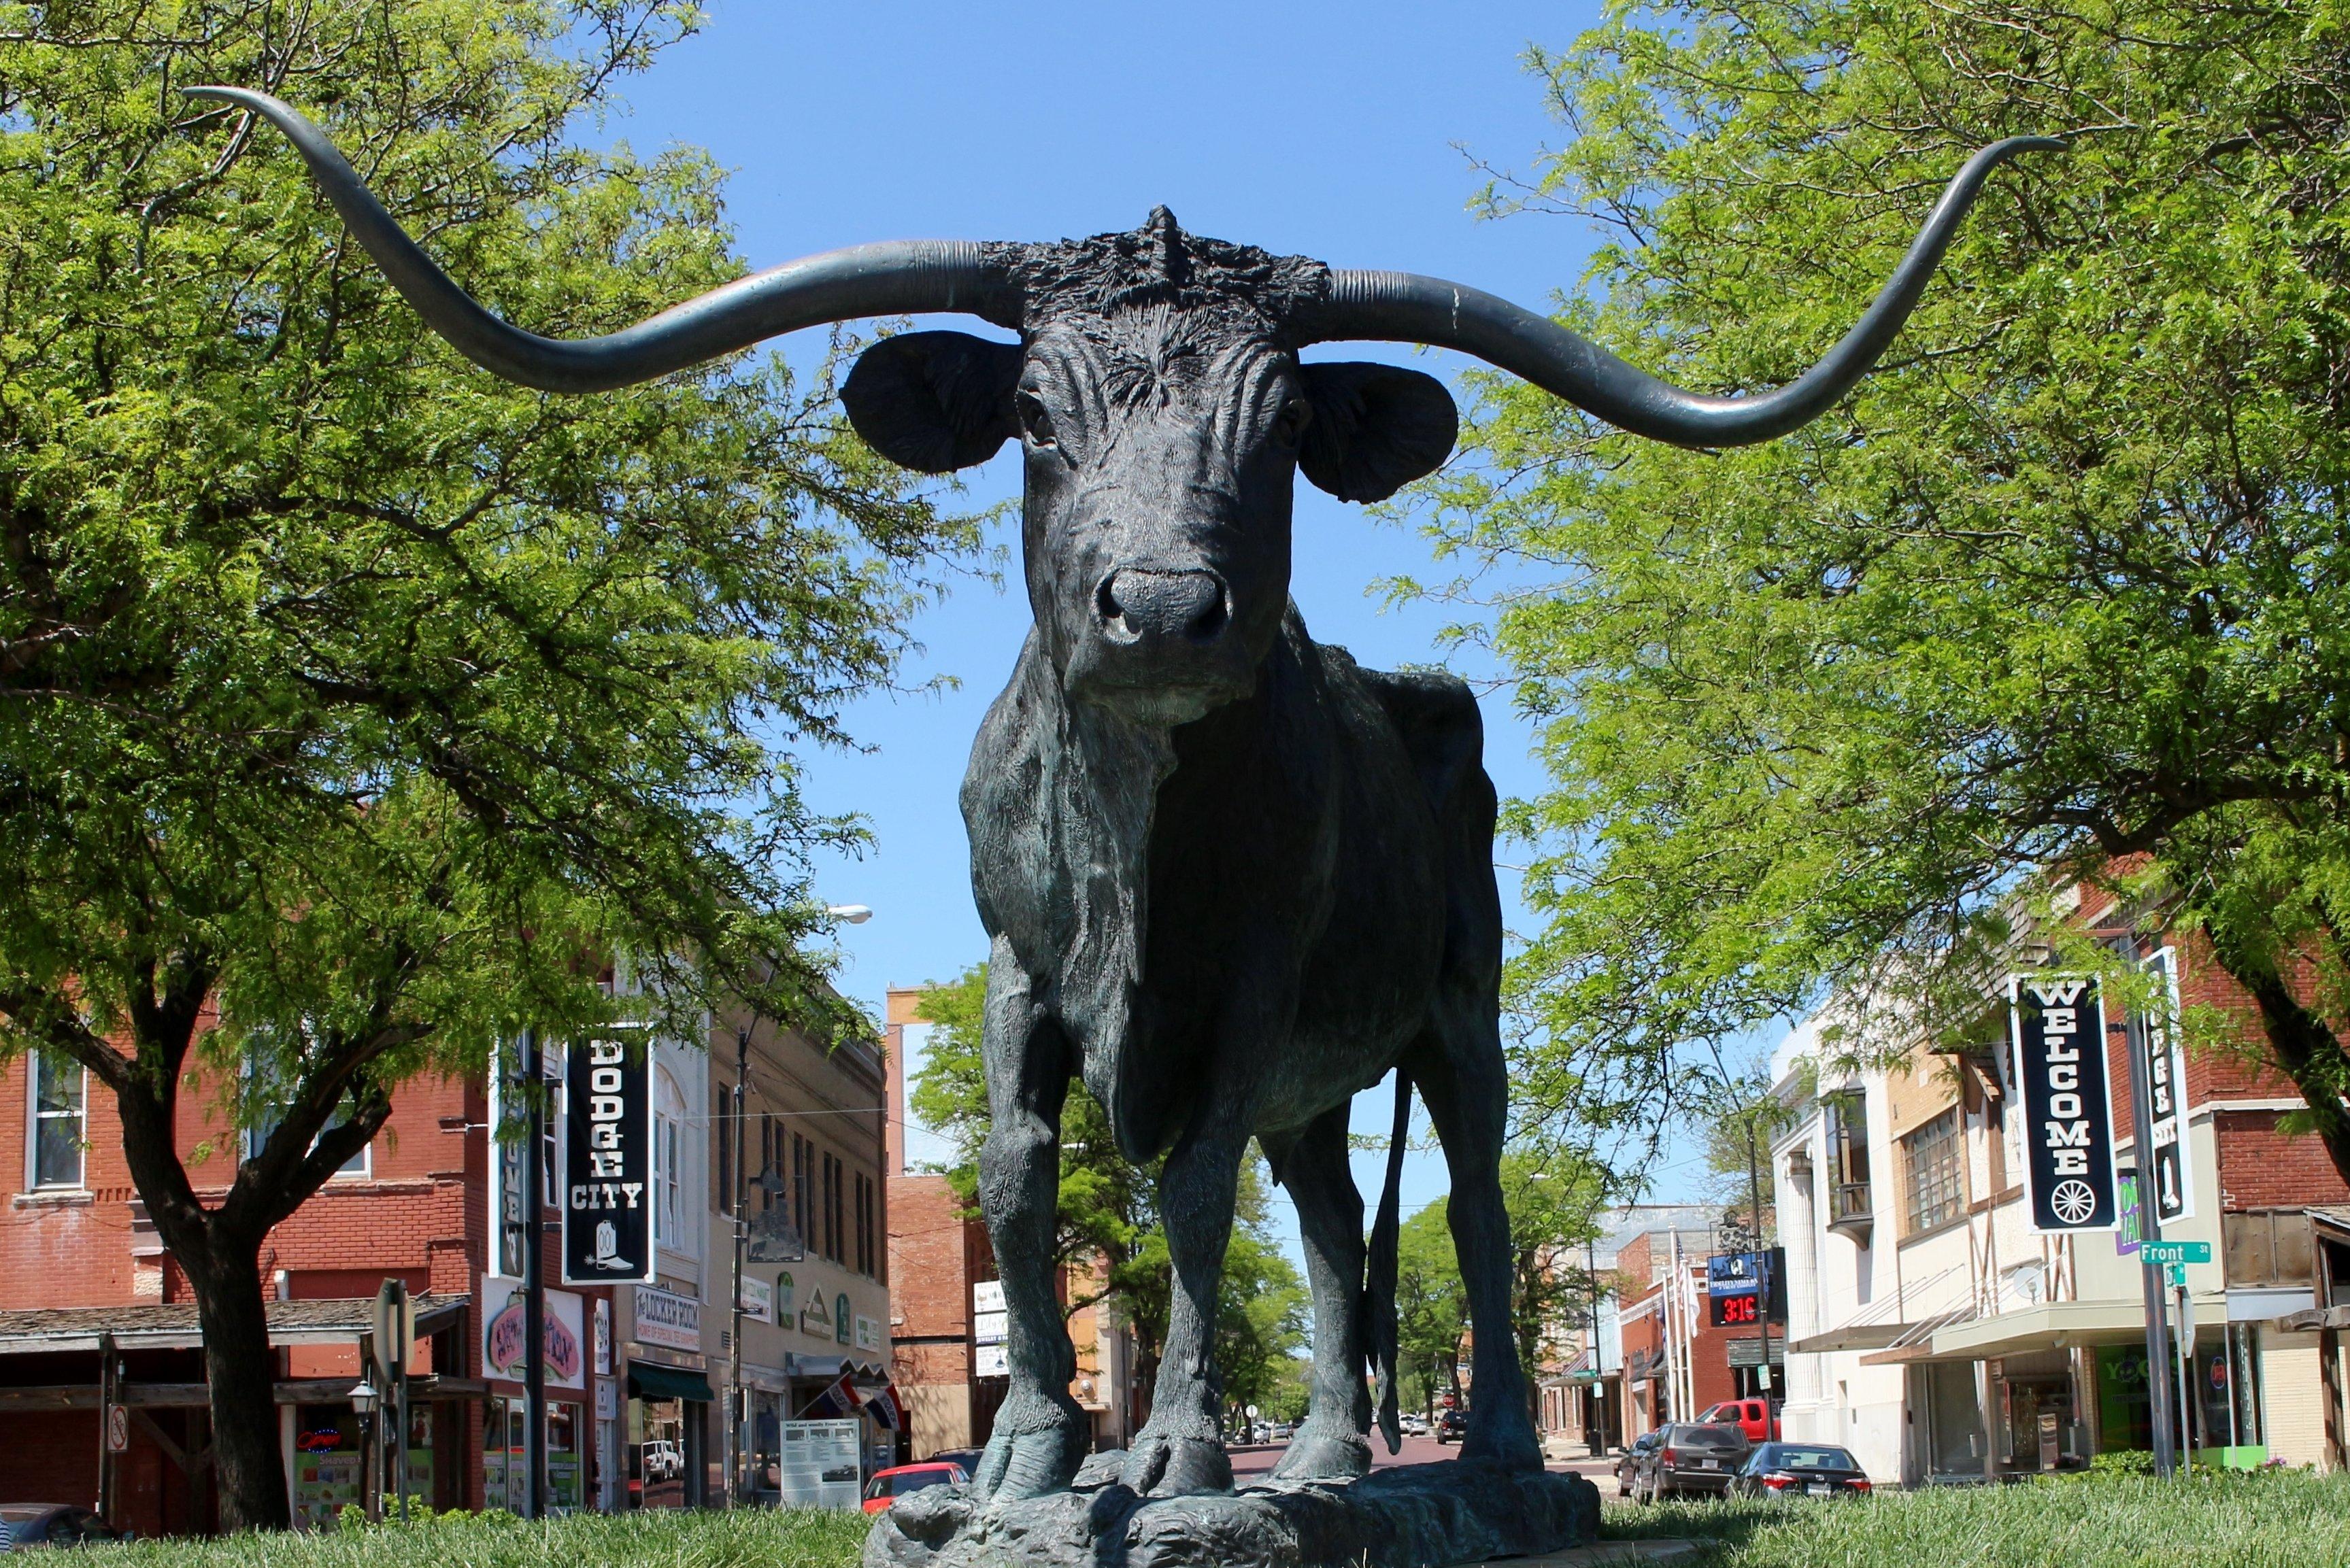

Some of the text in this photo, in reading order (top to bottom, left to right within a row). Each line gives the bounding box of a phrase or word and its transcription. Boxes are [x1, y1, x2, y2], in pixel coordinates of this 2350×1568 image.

[2026, 980, 2091, 1176] WELCOME
[590, 1040, 624, 1178] DODGE
[571, 1182, 643, 1210] CITY
[2141, 1244, 2209, 1261] Front St
[646, 1293, 677, 1326] LOCKER
[678, 1300, 699, 1331] ROOM
